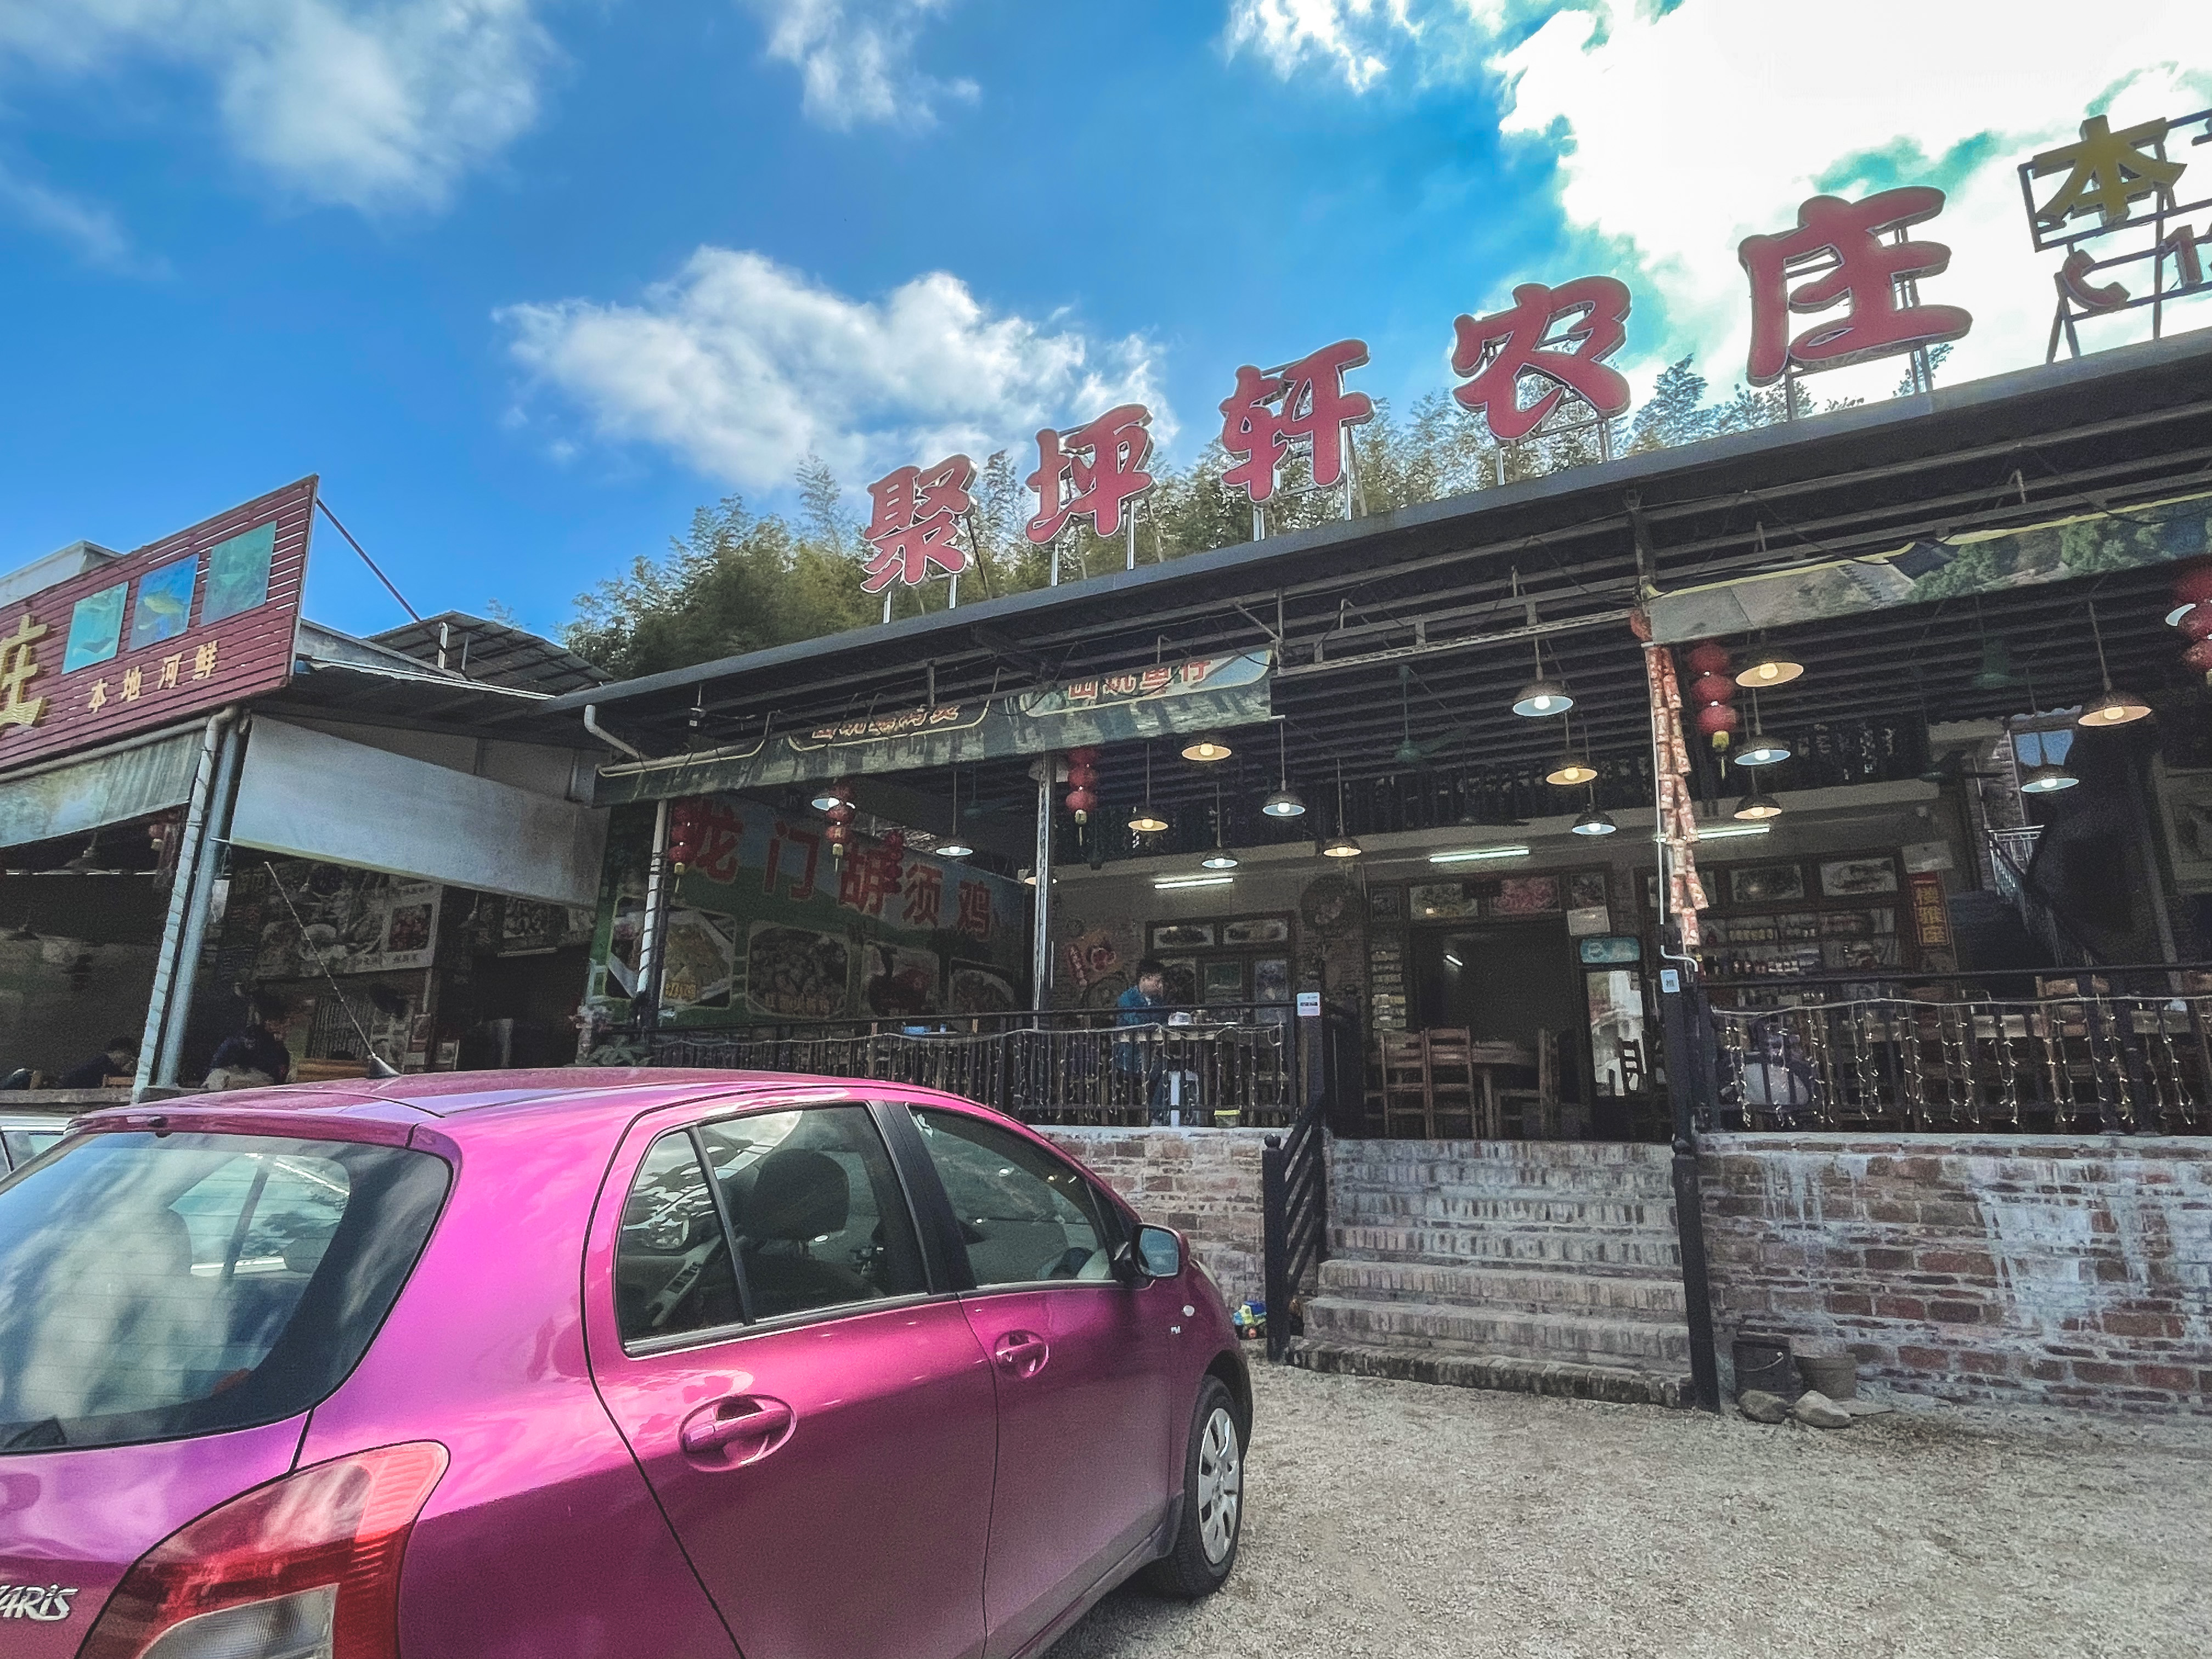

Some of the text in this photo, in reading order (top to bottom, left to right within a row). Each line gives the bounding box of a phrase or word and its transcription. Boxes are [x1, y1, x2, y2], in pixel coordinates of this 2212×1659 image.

[2032, 112, 2212, 226] 本
[860, 185, 1973, 594] 聚坪轩农庄
[88, 640, 218, 714] 本地河鲜
